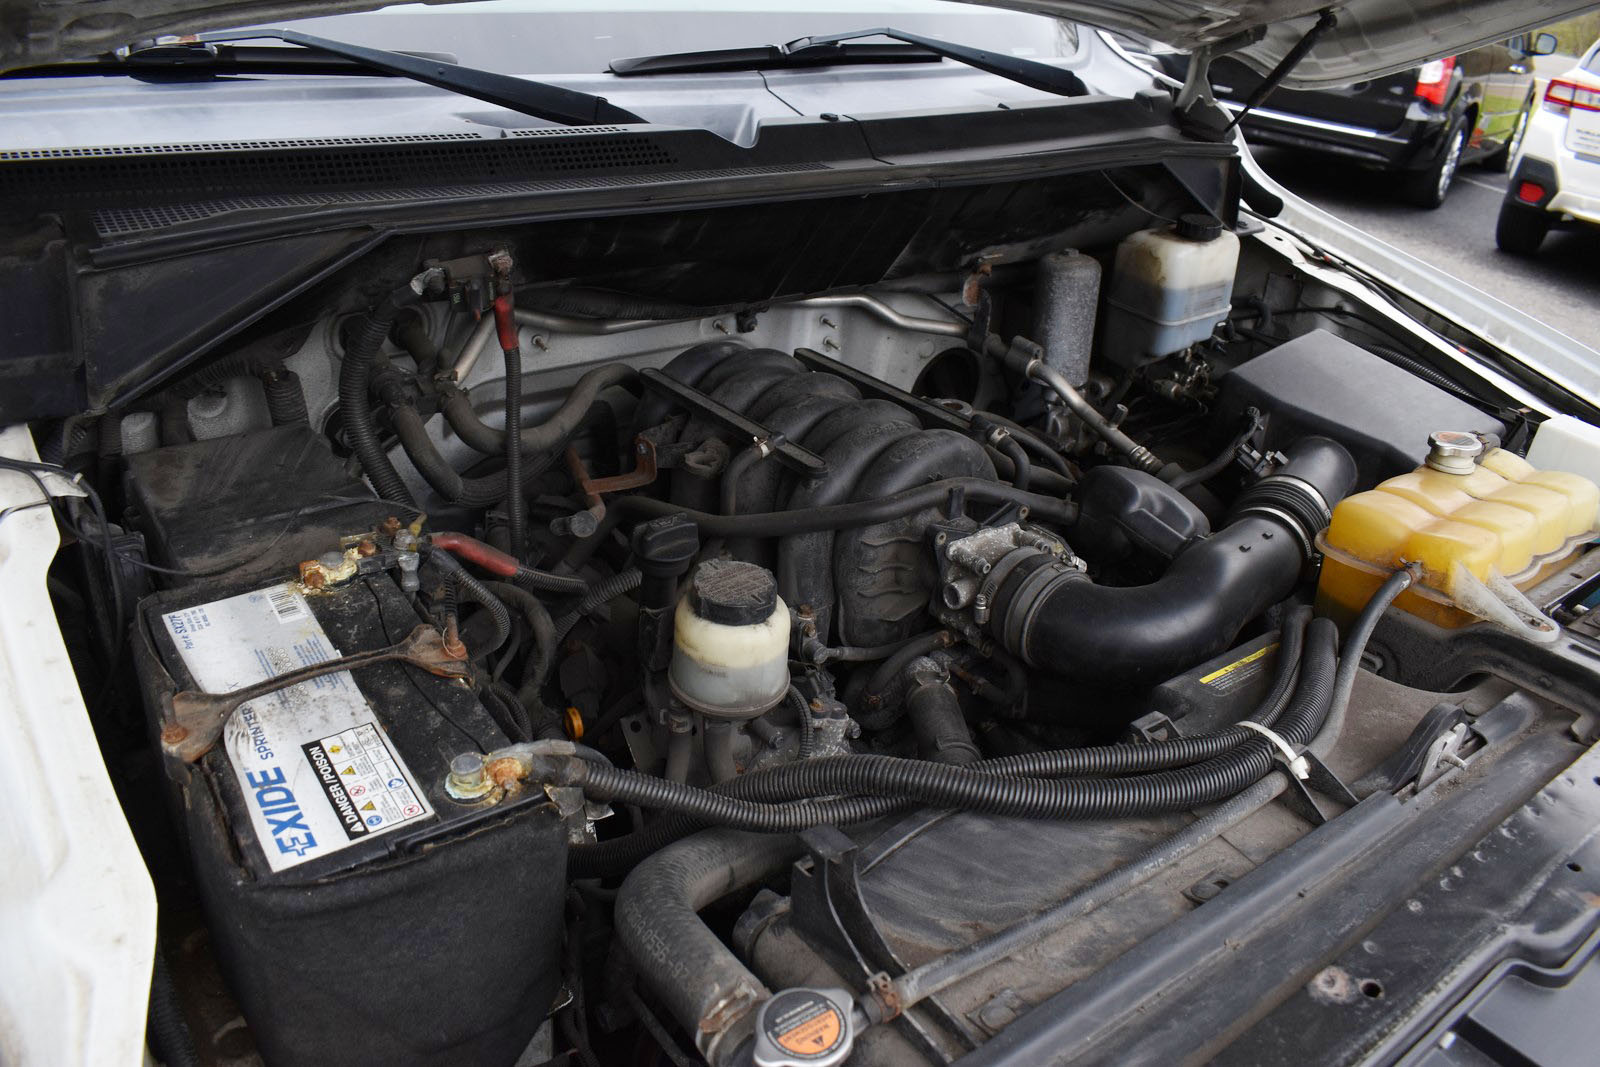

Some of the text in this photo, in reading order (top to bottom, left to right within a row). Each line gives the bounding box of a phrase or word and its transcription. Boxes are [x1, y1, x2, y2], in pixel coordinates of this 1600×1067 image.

[168, 614, 187, 634] SX27F
[184, 639, 195, 649] Part
[241, 705, 274, 760] SPRINTER
[246, 766, 318, 857] EXIDE
[328, 783, 361, 824] DANGER
